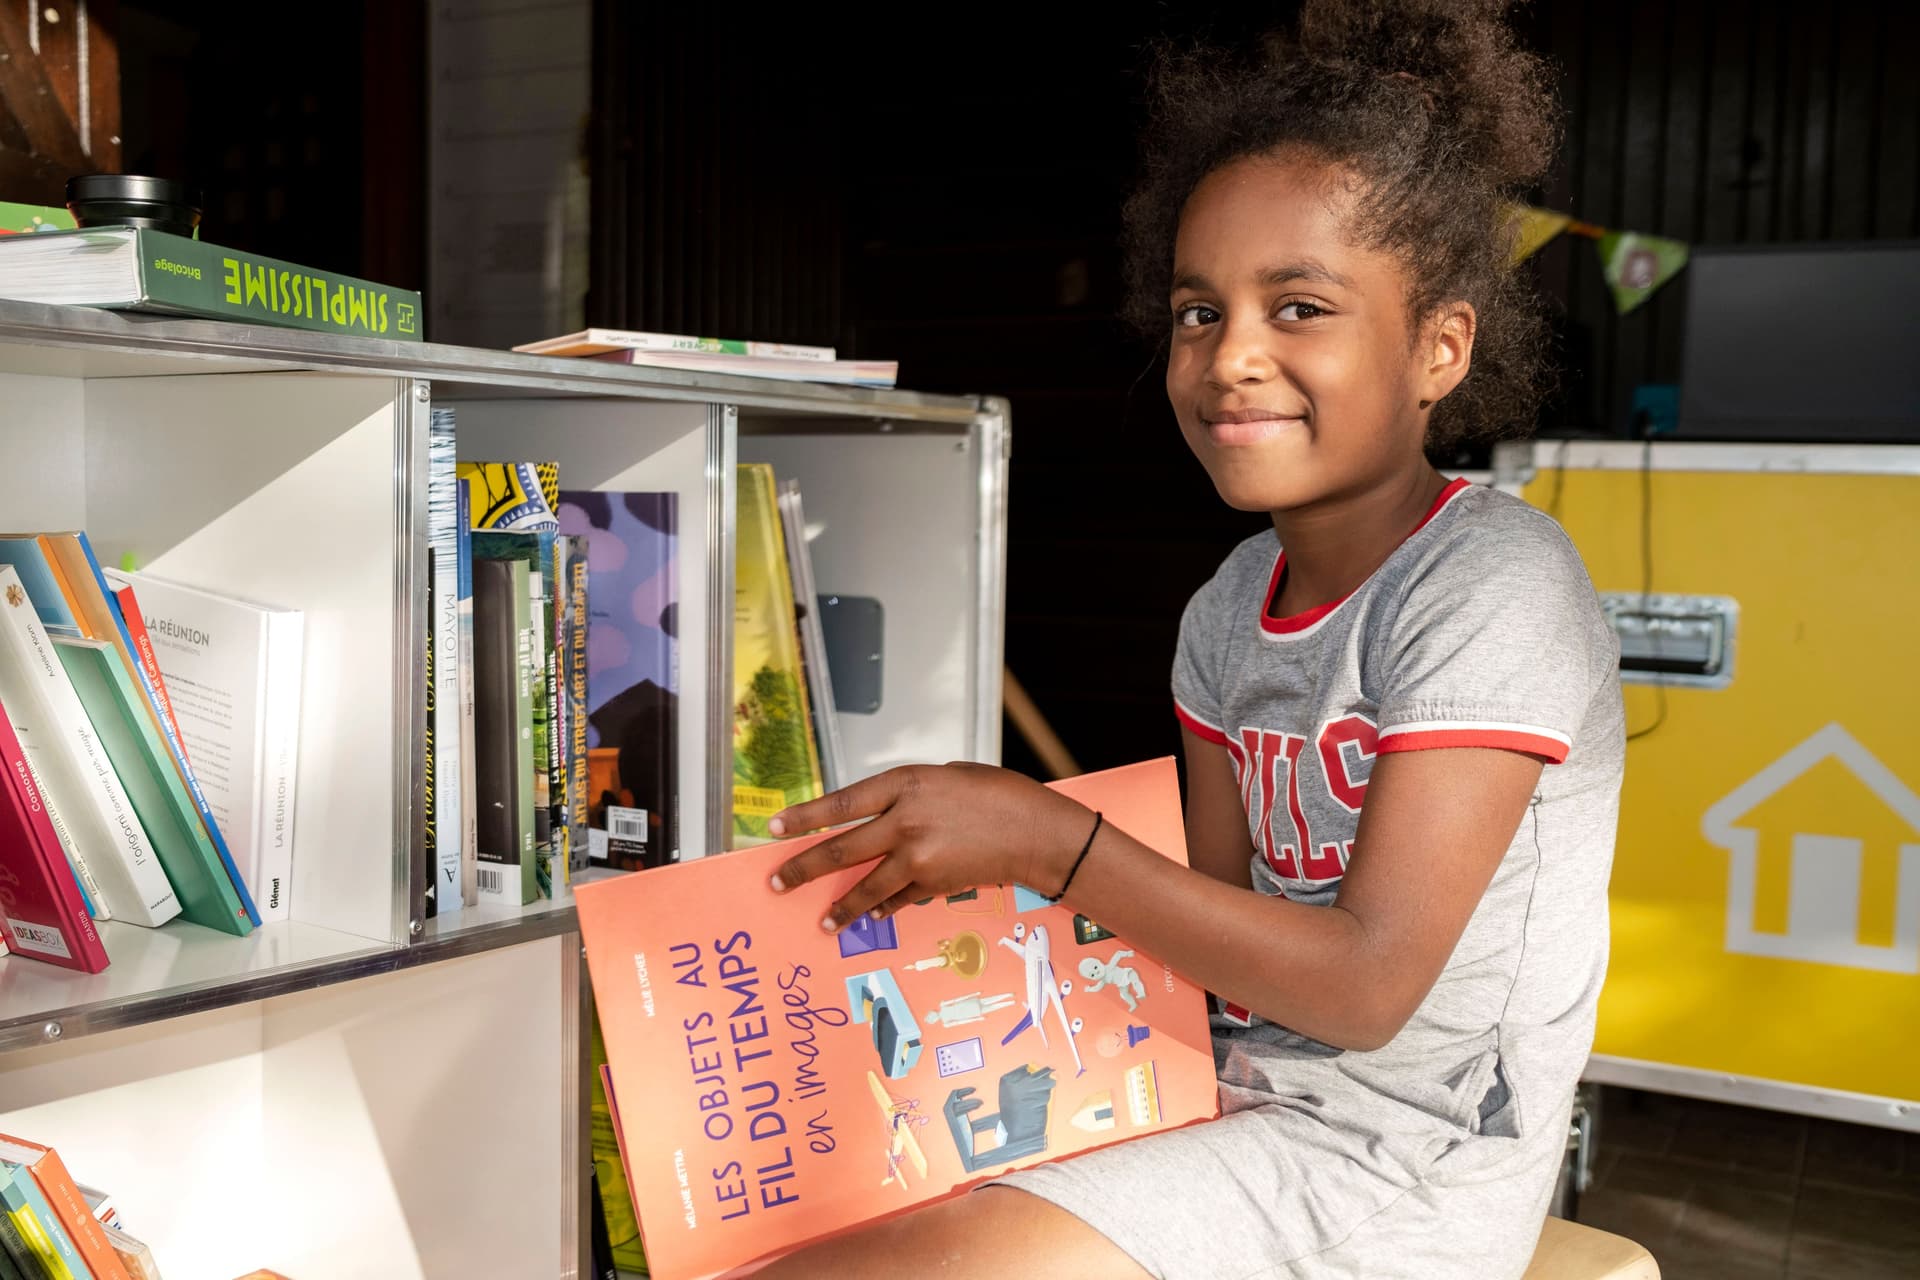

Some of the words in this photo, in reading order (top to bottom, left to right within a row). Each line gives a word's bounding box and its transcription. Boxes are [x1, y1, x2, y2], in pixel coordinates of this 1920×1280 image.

[154, 258, 202, 280] Bricolage
[223, 257, 387, 333] SIMPLISSIME
[574, 561, 588, 627] GRAFFITI
[160, 617, 210, 647] RÉUNION
[444, 593, 457, 689] MAYOTTE
[574, 628, 586, 649] DU
[38, 647, 55, 677] Adeline
[138, 634, 157, 679] Campings
[574, 654, 587, 671] ET
[153, 679, 161, 690] et
[549, 677, 557, 692] DU
[574, 677, 587, 700] ART
[549, 695, 558, 719] VUE
[574, 704, 587, 754] STREET
[93, 761, 109, 777] par
[550, 769, 559, 784] LA
[575, 757, 586, 776] DU
[16, 760, 41, 812] Comores
[101, 778, 121, 814] comme
[277, 776, 286, 832] RÉUNION
[575, 782, 588, 824] ATLAS
[118, 814, 146, 866] l'origami
[275, 833, 284, 848] LA
[270, 877, 281, 909] Glénat
[13, 925, 62, 947] IDEASBOX
[79, 909, 96, 942] GRANDIR
[669, 943, 708, 988] AU
[640, 988, 655, 1017] MÉLIE
[714, 930, 773, 1073] TEMPS
[777, 961, 849, 1103] images
[683, 1012, 734, 1141] OBJETS
[741, 1080, 787, 1141] DU
[805, 1109, 836, 1154] en
[673, 1149, 690, 1187] METTRA
[756, 1146, 800, 1209] FIL
[680, 1188, 697, 1230] MÉLANIE
[712, 1161, 750, 1221] LES
